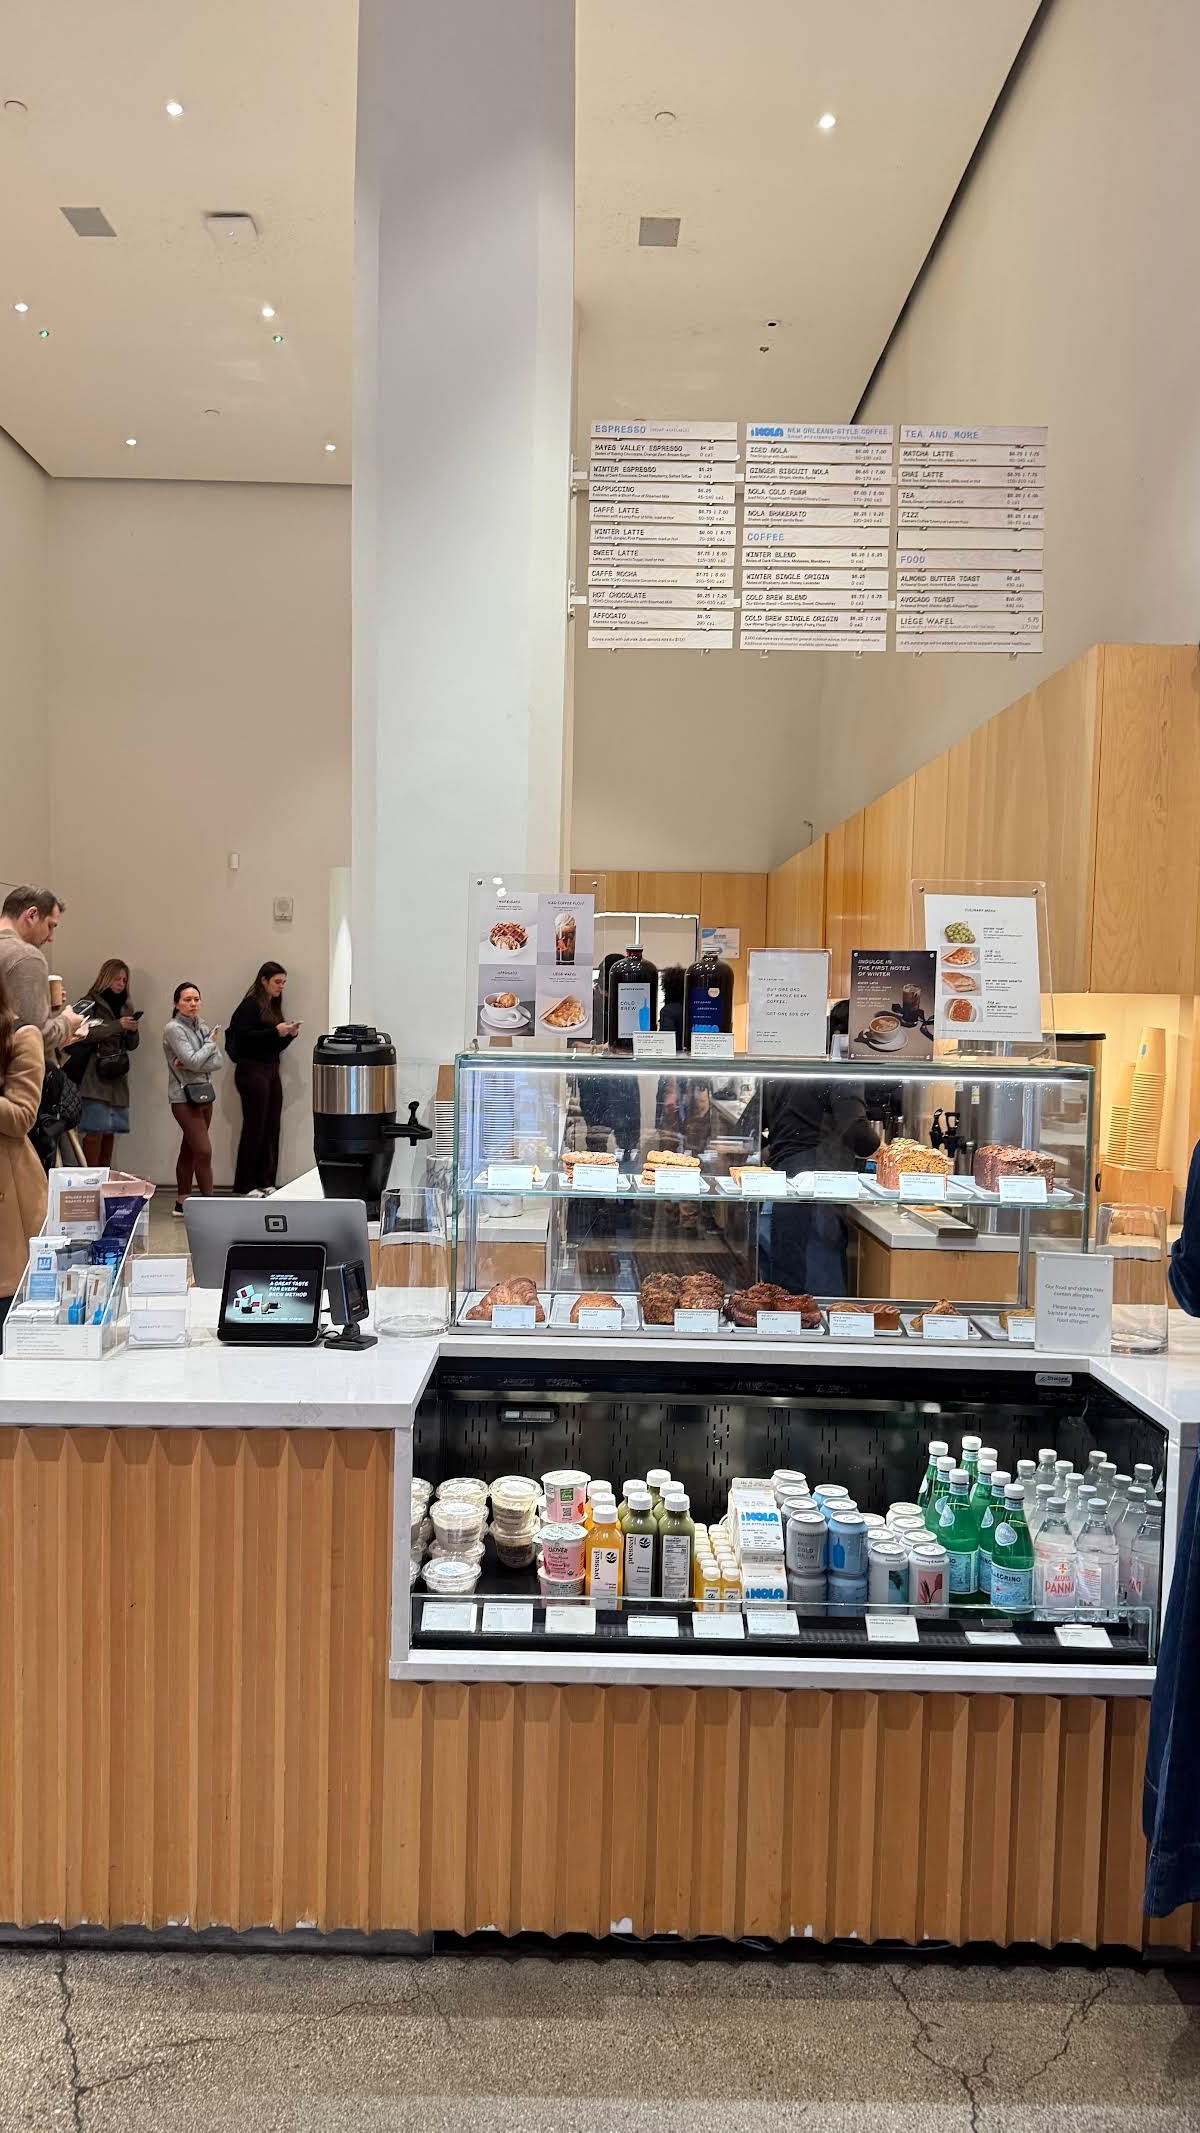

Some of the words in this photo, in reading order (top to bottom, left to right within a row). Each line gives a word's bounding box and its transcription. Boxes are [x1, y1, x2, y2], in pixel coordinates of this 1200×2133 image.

[595, 425, 646, 434] ESPRESSO
[755, 427, 784, 437] NOLA
[905, 430, 923, 438] TEA
[929, 431, 948, 439] AND
[954, 432, 979, 440] MORE
[747, 533, 784, 541] COFFEE
[900, 556, 926, 564] FOOD
[927, 617, 955, 625] WAFEL
[746, 1512, 779, 1522] NOLA
[751, 1588, 784, 1599] NOLA
